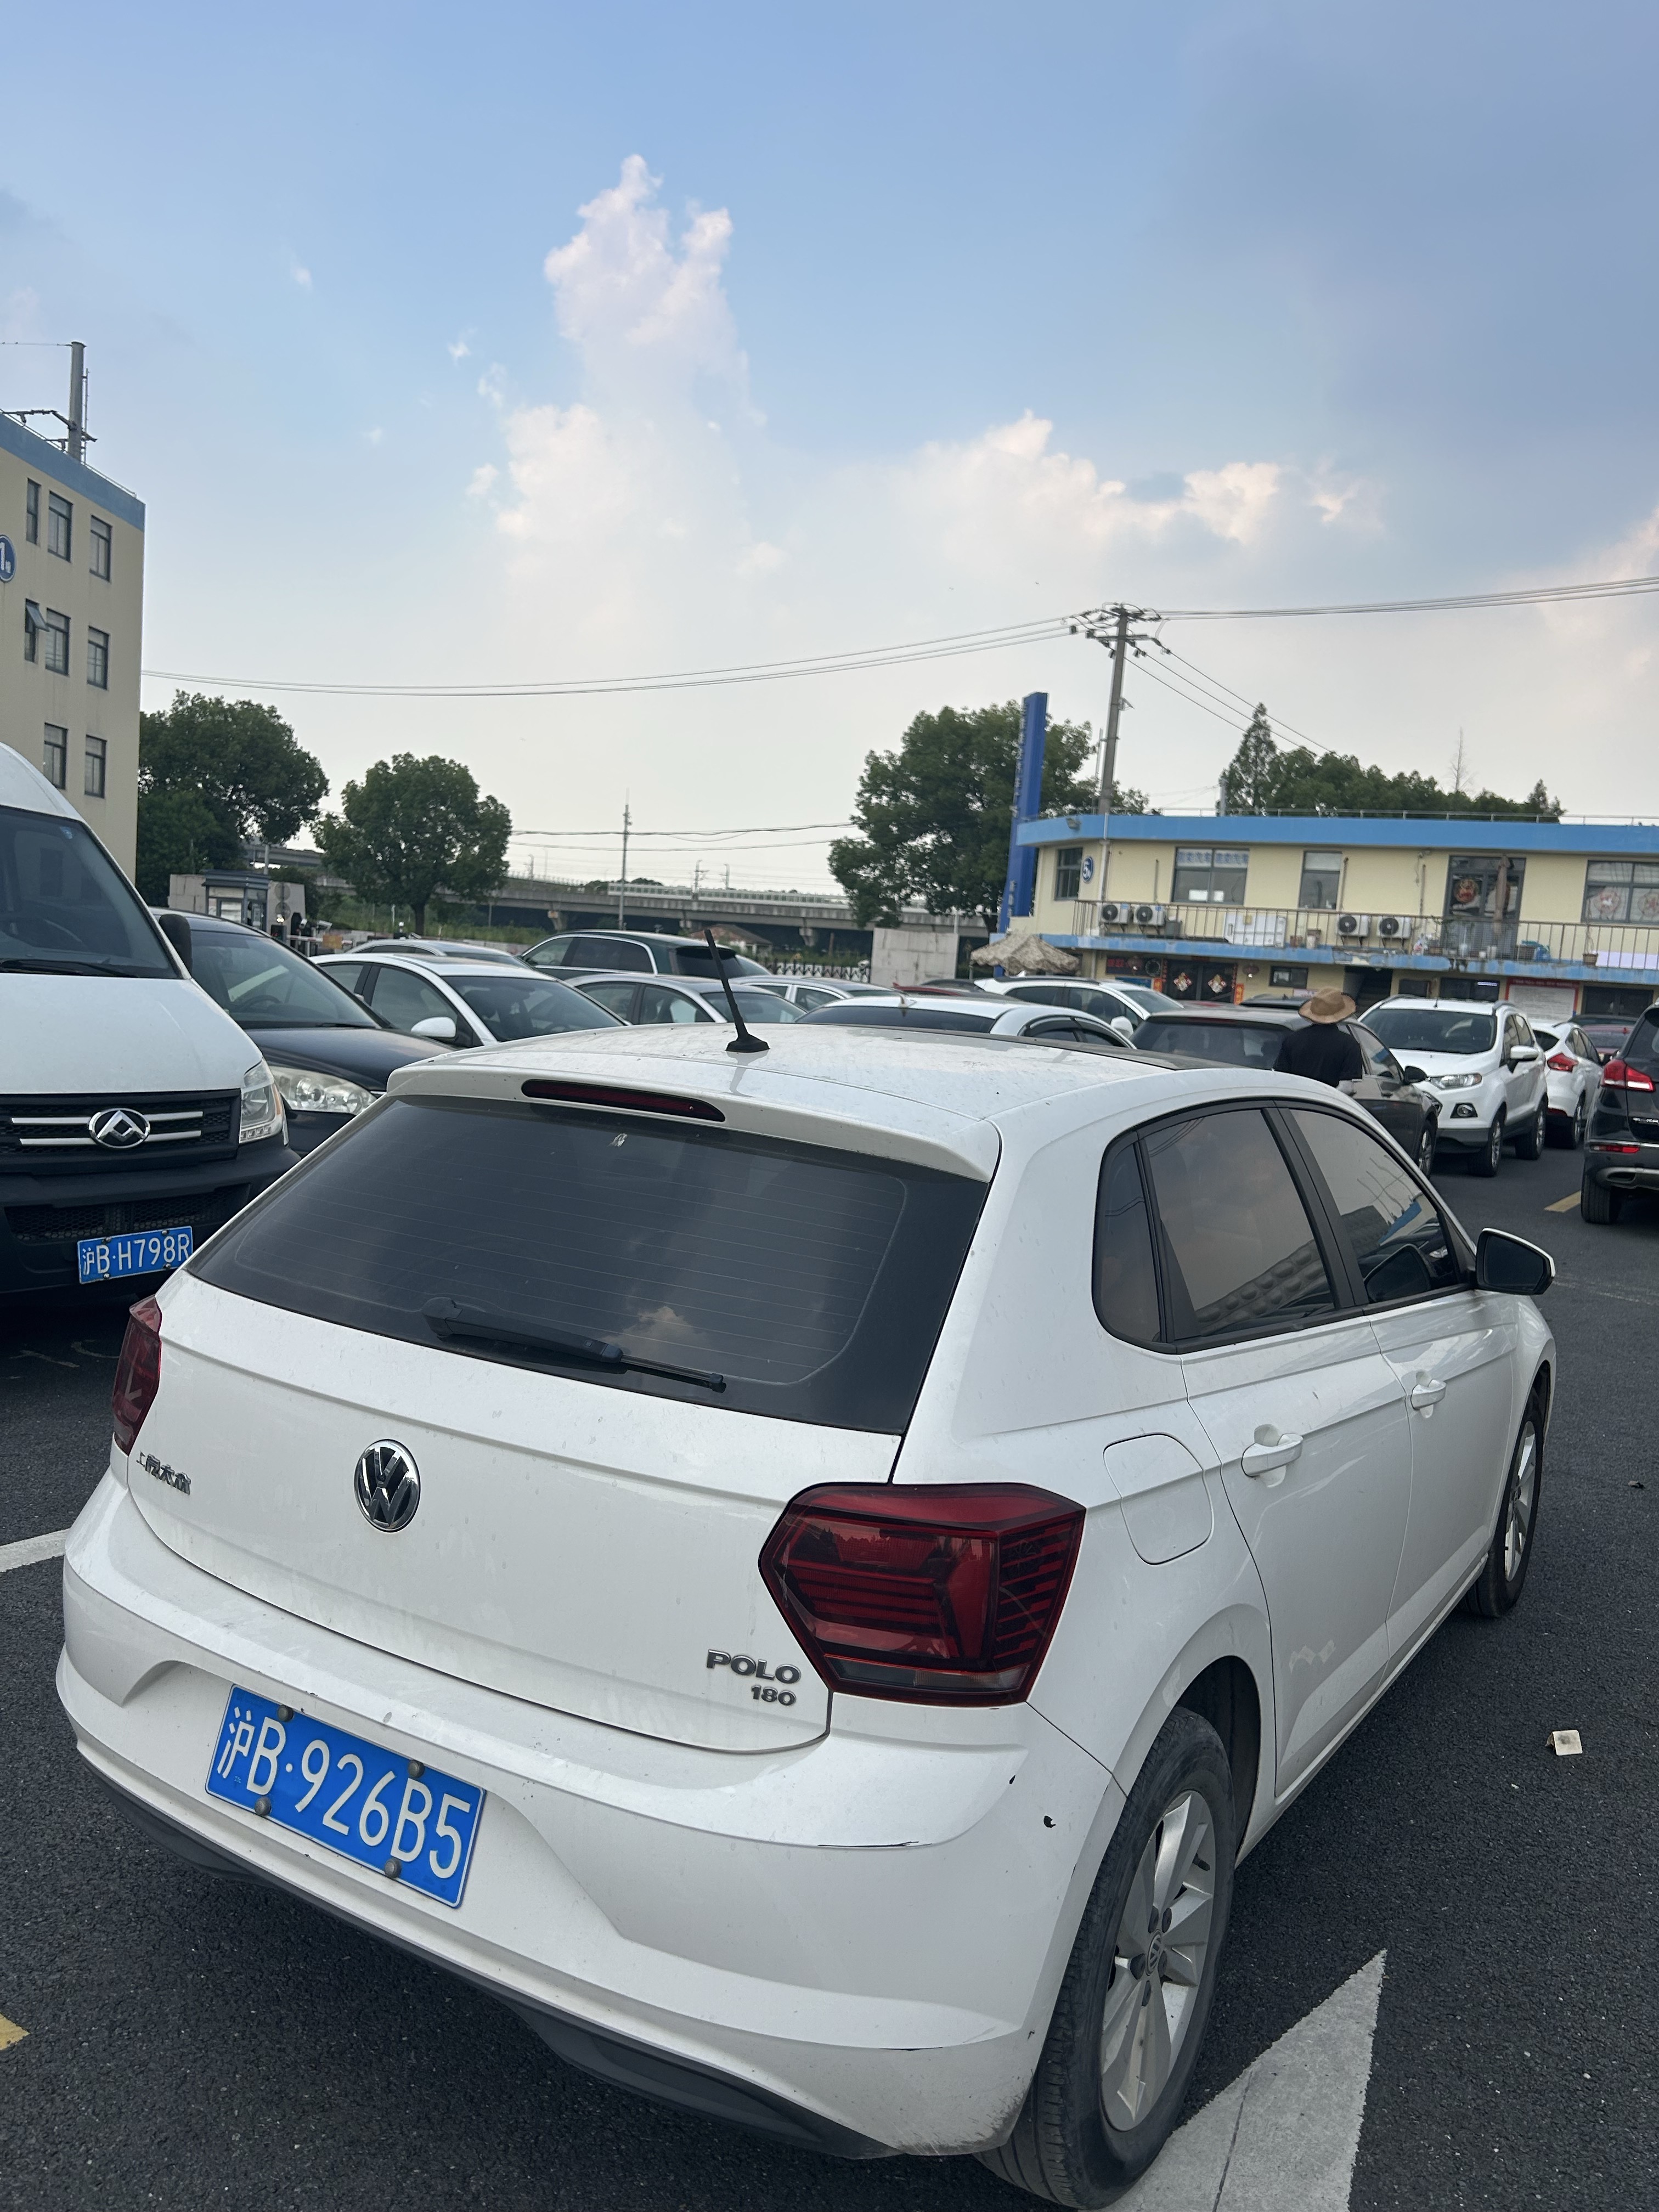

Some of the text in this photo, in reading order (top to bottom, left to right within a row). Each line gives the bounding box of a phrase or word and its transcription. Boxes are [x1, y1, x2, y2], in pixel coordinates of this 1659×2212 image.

[82, 1233, 190, 1276] 沪B·H798R
[706, 1649, 802, 1684] POLO
[751, 1684, 797, 1706] 180
[217, 1707, 471, 1879] 沪B·926B5
